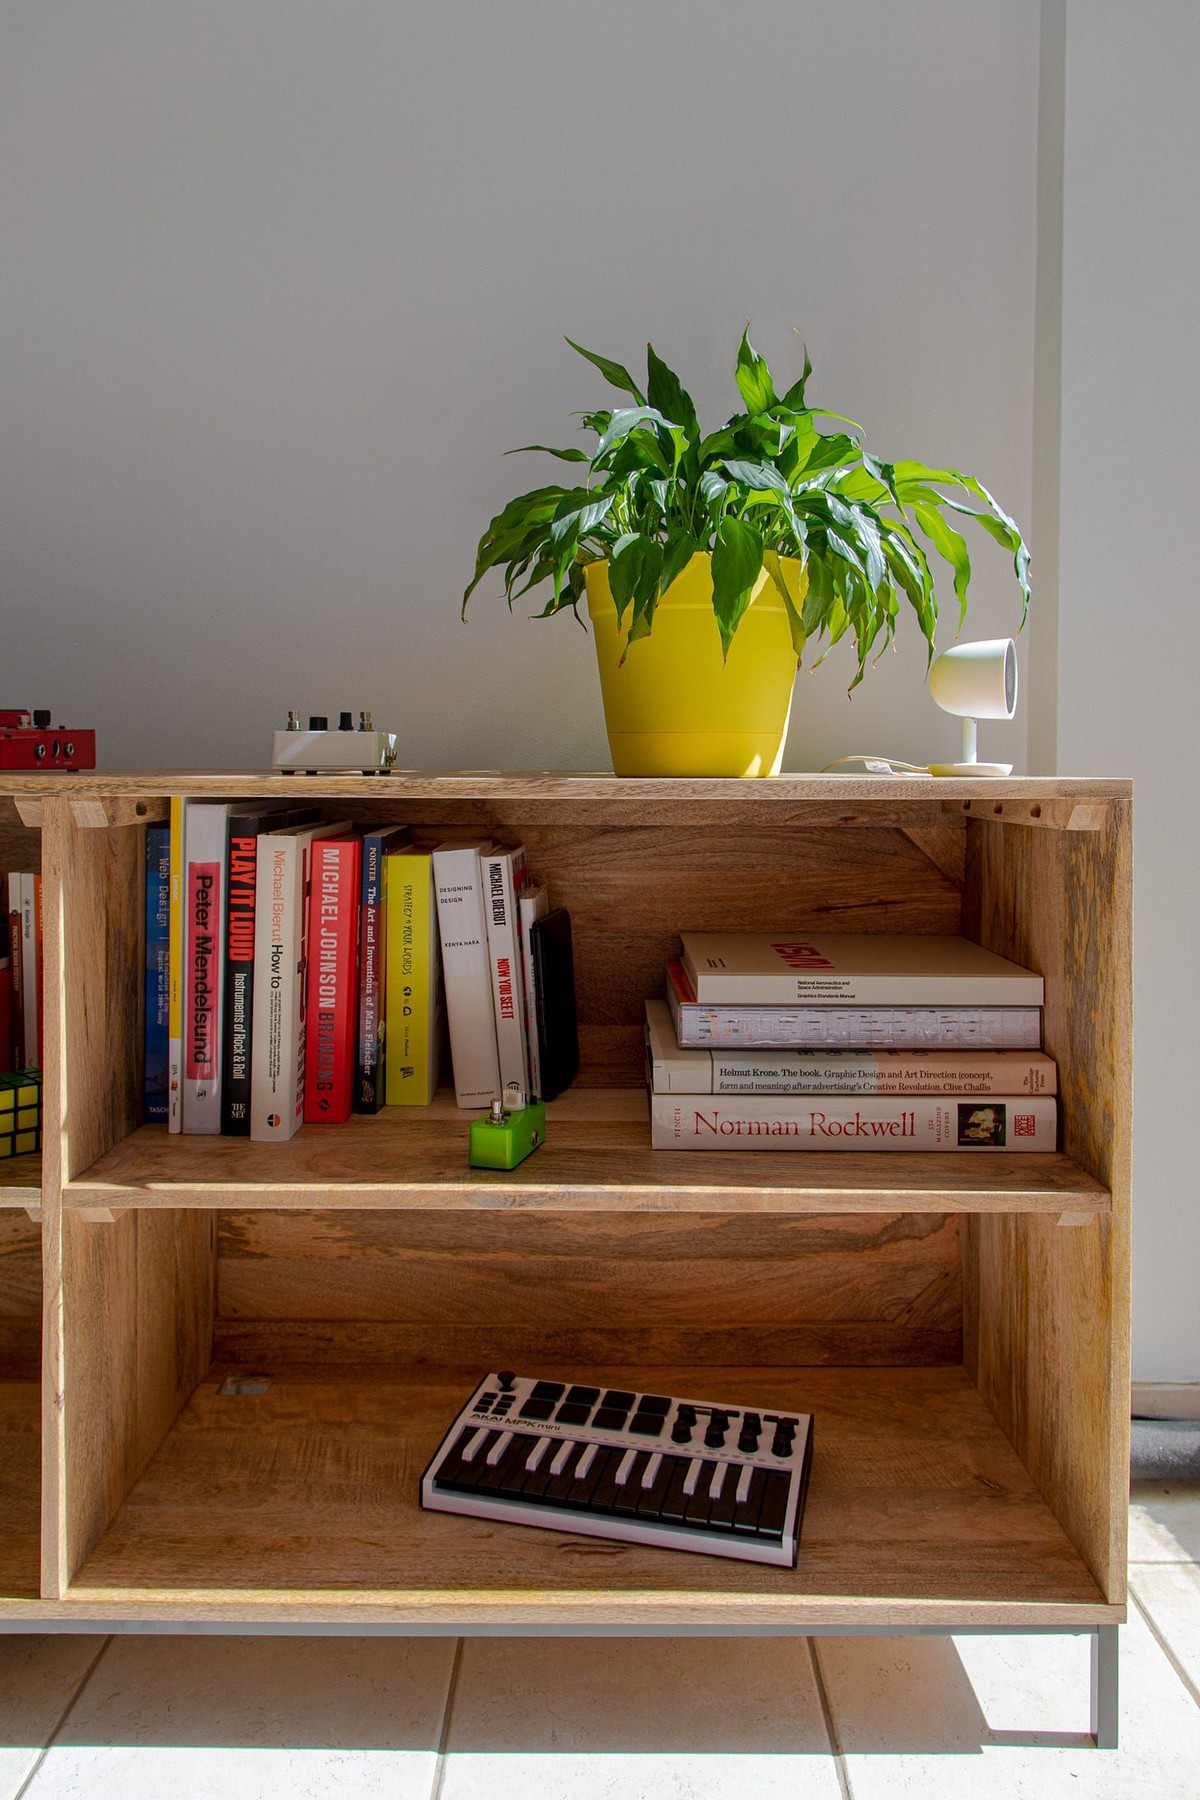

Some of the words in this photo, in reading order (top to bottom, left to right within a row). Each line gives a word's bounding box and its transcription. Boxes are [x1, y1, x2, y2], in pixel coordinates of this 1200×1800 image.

[159, 858, 170, 880] Web
[230, 838, 256, 884] PLAY
[368, 847, 376, 882] POINTER
[273, 850, 286, 900] Michael
[320, 848, 340, 924] MICHAEL
[488, 863, 504, 898] MICHAEL
[156, 886, 170, 927] Design
[196, 874, 213, 930] Peter
[230, 889, 256, 907] IT
[368, 886, 376, 904] The
[403, 884, 412, 918] STRATEGY
[272, 903, 284, 942] Bierut
[368, 908, 376, 923] Art
[492, 899, 506, 926] BIERUT
[229, 912, 254, 962] LOUD
[367, 925, 375, 942] and
[402, 925, 413, 946] YOUR
[271, 944, 284, 973] How
[318, 928, 338, 1008] JOHNSON
[366, 946, 375, 994] Inventions
[402, 948, 412, 975] WORDS
[497, 958, 510, 978] NOW
[271, 975, 282, 989] to
[499, 980, 512, 996] YOU
[194, 936, 212, 1064] Mendelsund
[234, 973, 247, 1022] Instruments
[366, 996, 374, 1007] of
[500, 996, 513, 1011] SEE
[234, 1024, 246, 1033] of
[366, 1010, 374, 1030] Max
[501, 1011, 514, 1020] IT
[234, 1033, 246, 1054] Rock
[316, 1012, 335, 1092] BRANDING
[364, 1034, 373, 1076] Fleischer
[232, 1063, 245, 1080] Roll
[720, 1068, 751, 1077] Helmut
[752, 1069, 781, 1077] Krone.
[800, 1069, 822, 1077] book.
[824, 1070, 857, 1079] Graphic
[858, 1070, 886, 1079] Design
[919, 1070, 957, 1079] Direction
[958, 1070, 993, 1080] (concept,
[755, 1082, 791, 1091] meaning)
[898, 1083, 942, 1091] Revolution.
[693, 1111, 800, 1136] Norman
[808, 1112, 917, 1137] Rockwell
[470, 1414, 503, 1422] AKAI
